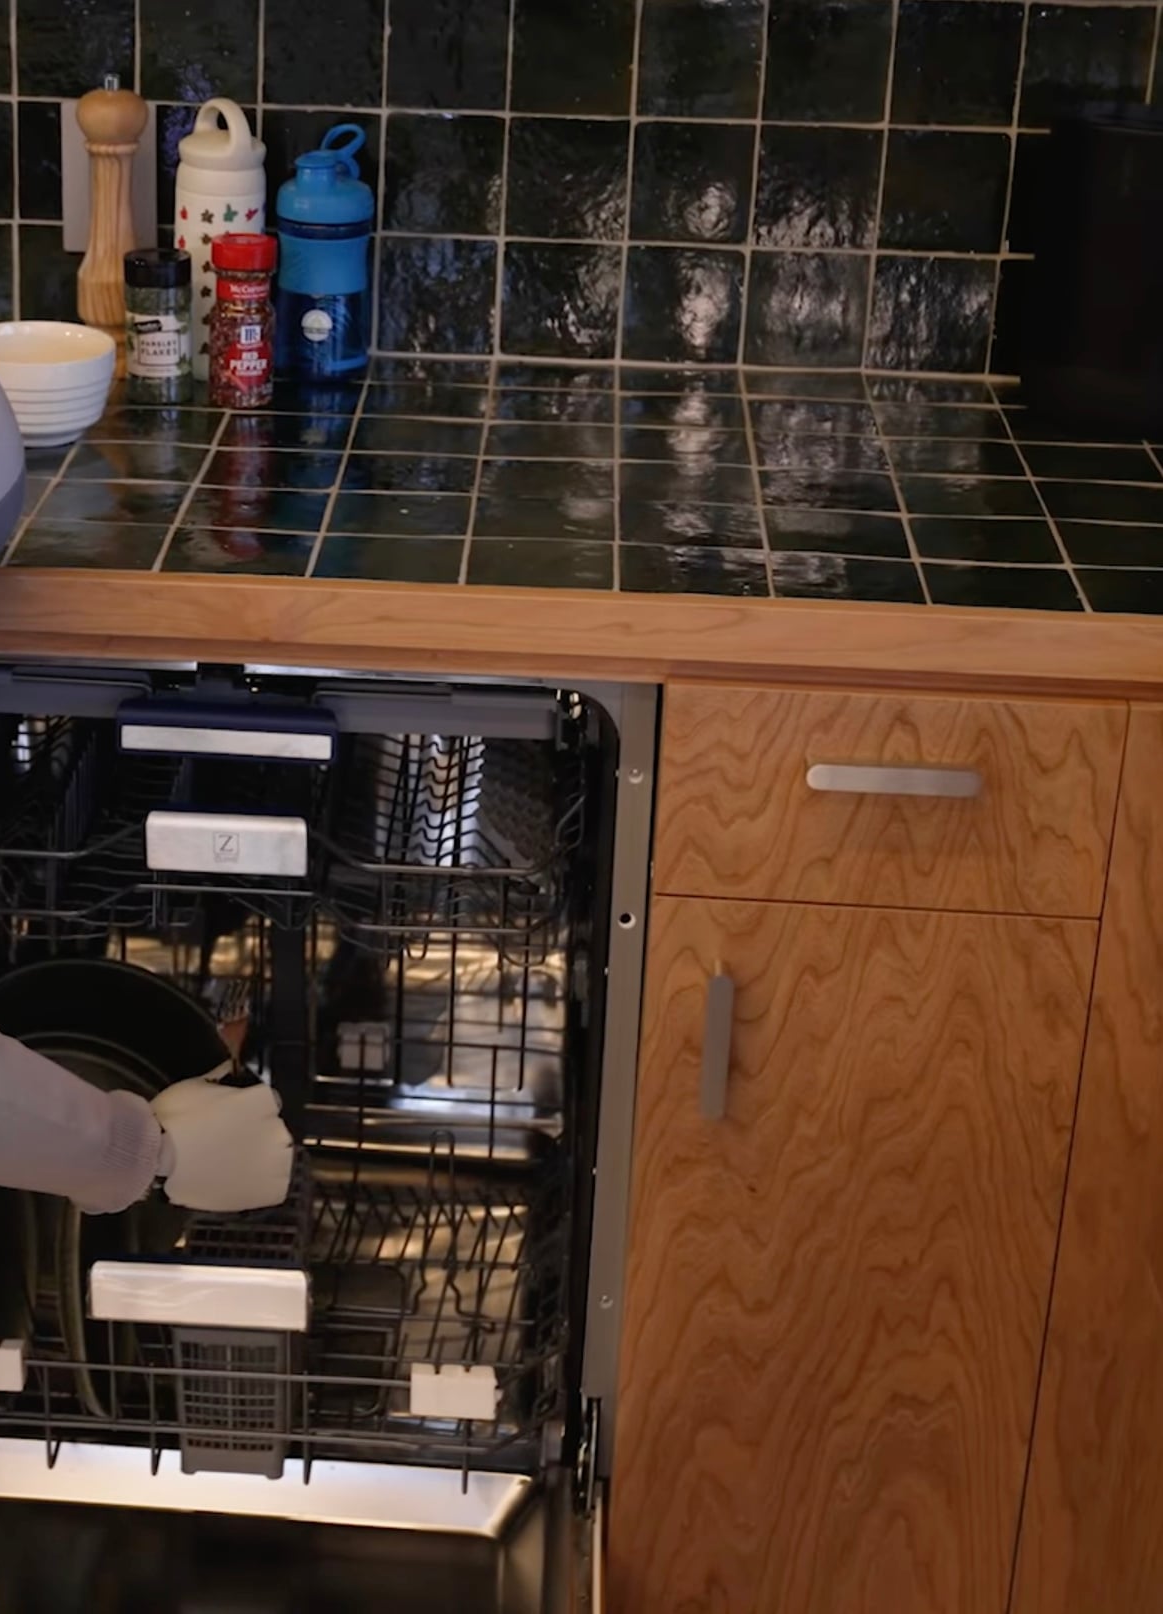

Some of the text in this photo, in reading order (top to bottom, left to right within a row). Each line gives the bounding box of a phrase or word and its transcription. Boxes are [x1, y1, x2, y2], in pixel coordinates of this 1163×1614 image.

[140, 348, 177, 356] FLAKES
[230, 359, 267, 371] PEPPER
[218, 834, 234, 852] Z
